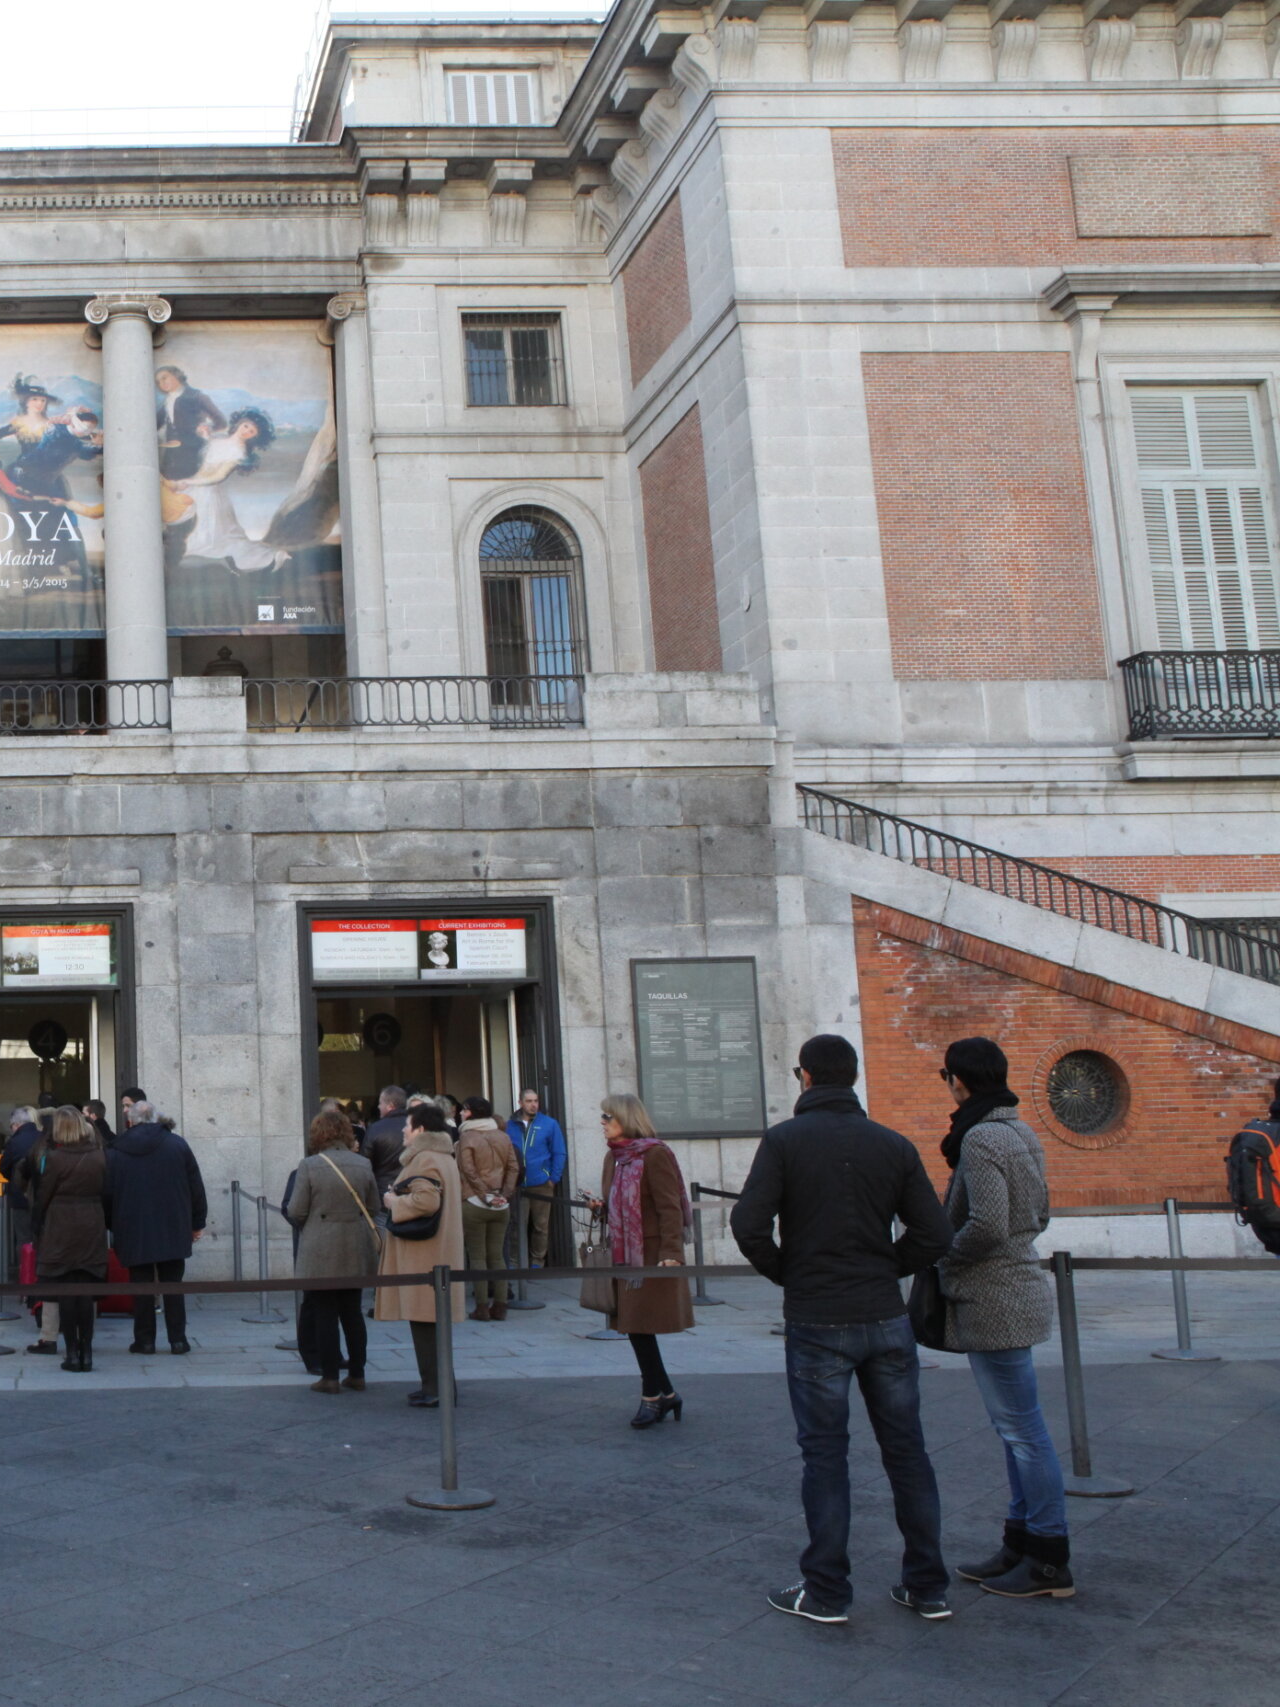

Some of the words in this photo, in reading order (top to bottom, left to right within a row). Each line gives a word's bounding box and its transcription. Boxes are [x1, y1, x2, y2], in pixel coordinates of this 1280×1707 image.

[22, 576, 68, 590] 3/5/2015
[468, 921, 506, 929] EXHIBITIONS
[648, 992, 688, 1000] TAQUILLAS
